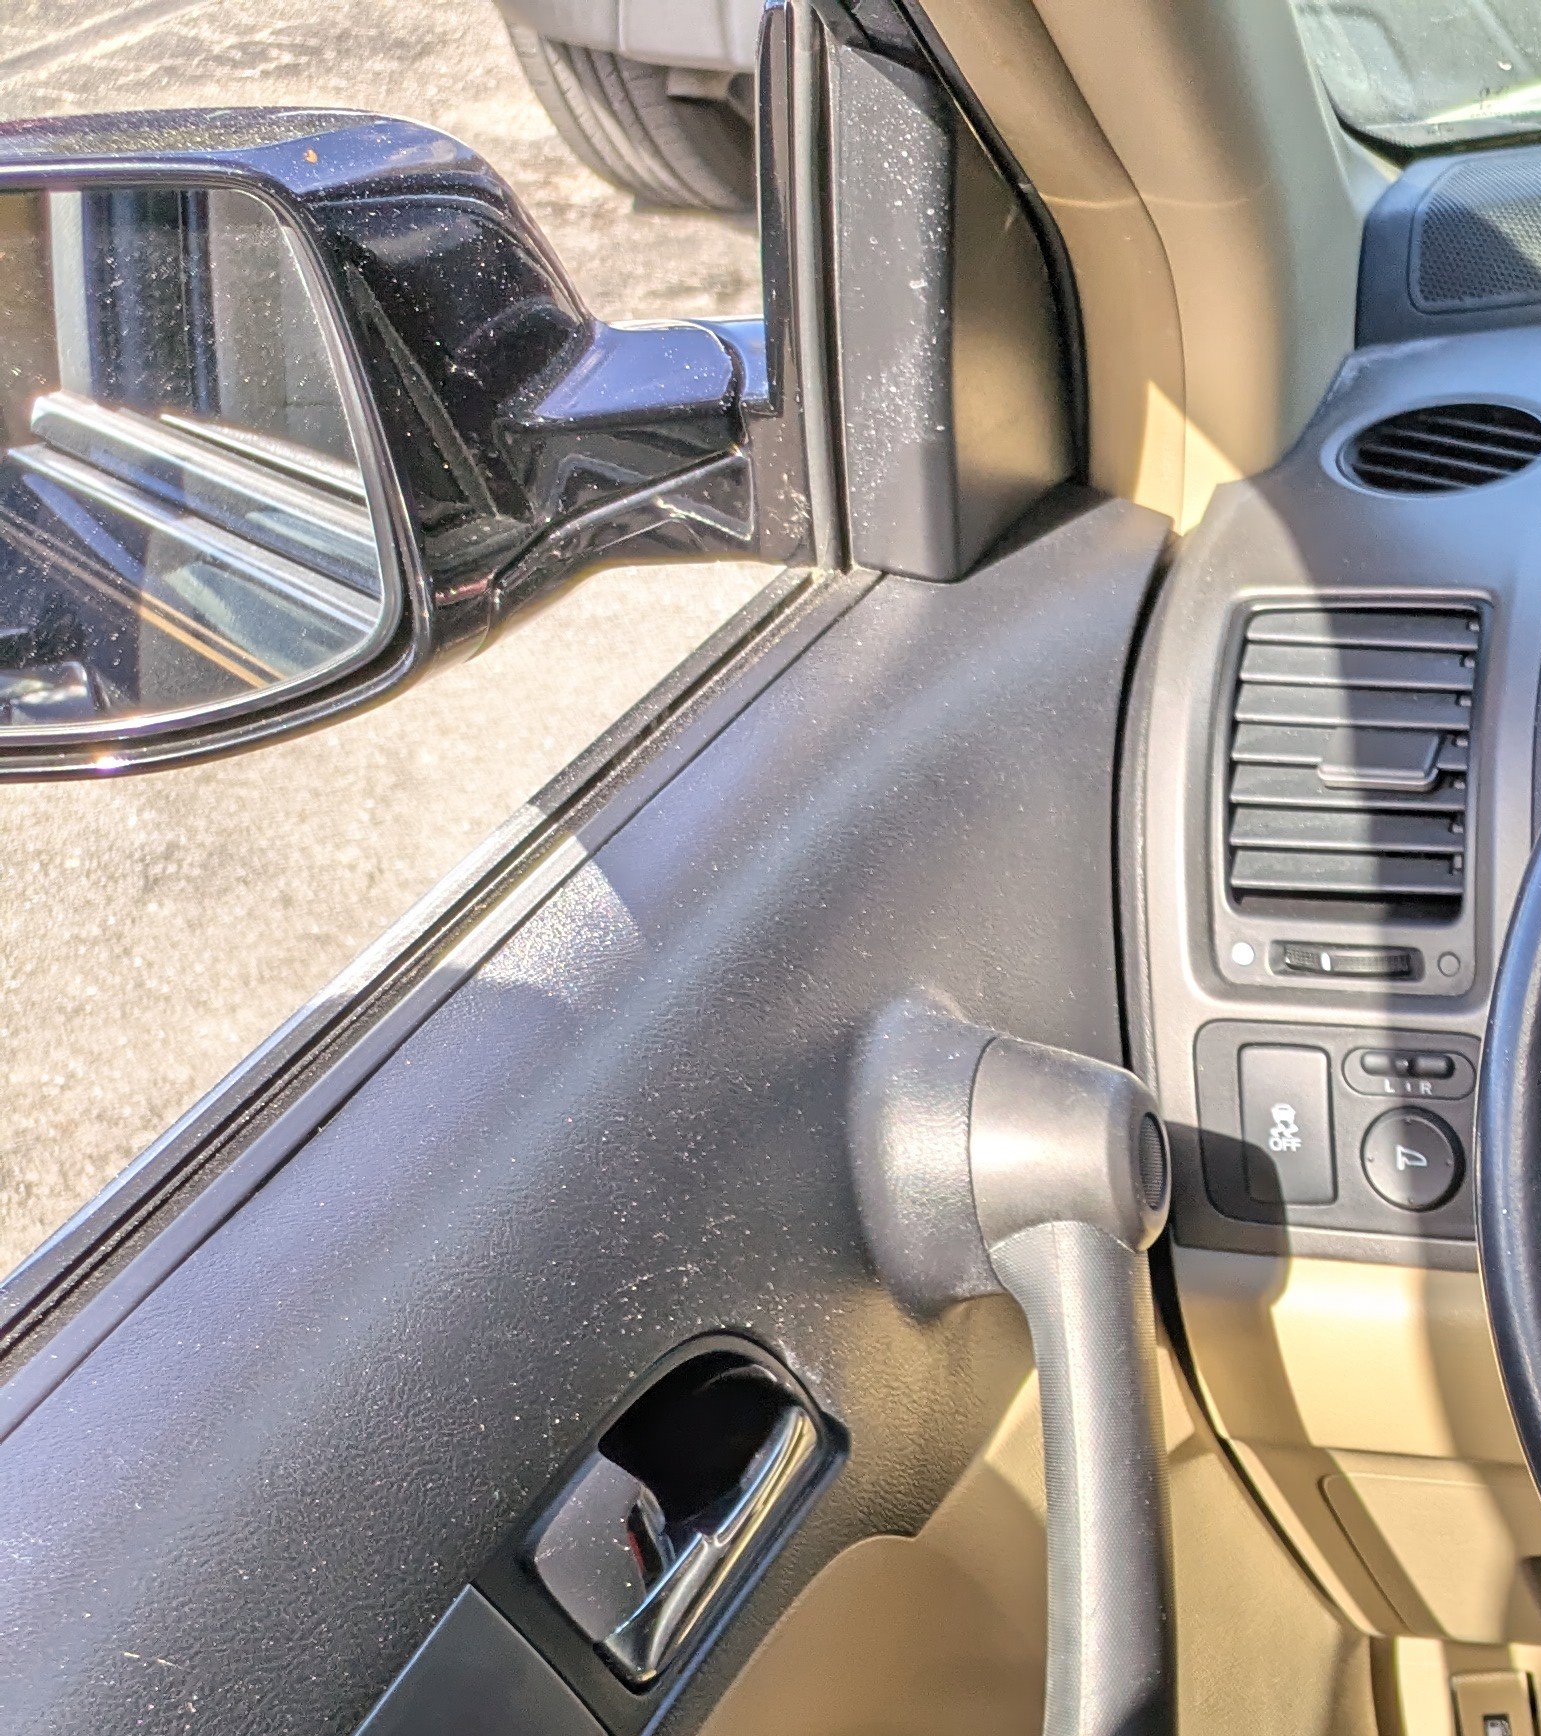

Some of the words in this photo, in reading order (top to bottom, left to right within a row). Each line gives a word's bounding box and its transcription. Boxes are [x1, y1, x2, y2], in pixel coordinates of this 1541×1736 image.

[1384, 1079, 1395, 1093] L
[1420, 1082, 1433, 1095] R
[1269, 1137, 1301, 1152] OFF
